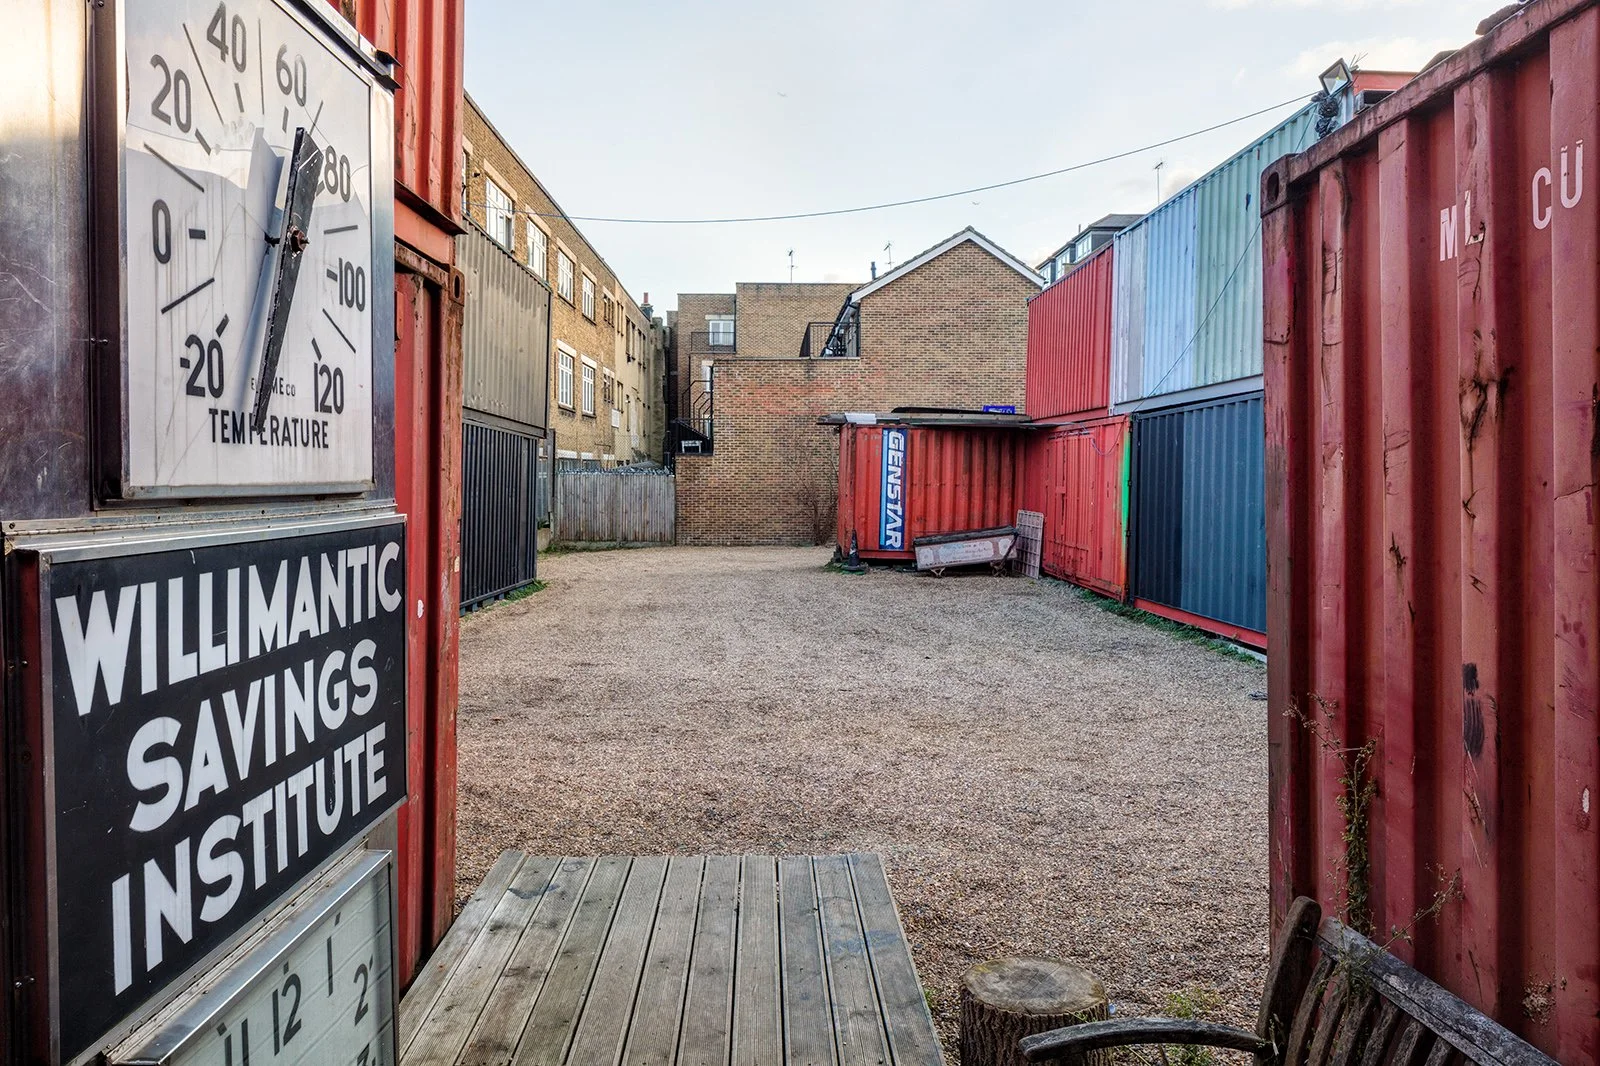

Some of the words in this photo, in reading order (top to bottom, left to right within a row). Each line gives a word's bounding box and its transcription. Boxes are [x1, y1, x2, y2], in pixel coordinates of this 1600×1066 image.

[206, 1, 247, 73] 40
[151, 54, 191, 134] 20
[276, 44, 307, 107] 60
[324, 145, 351, 202] 80
[152, 199, 172, 264] 0
[313, 362, 344, 414] 120
[886, 431, 905, 548] GENSTAR
[55, 542, 402, 716] WILLIMANTIC
[127, 639, 378, 832] SAVINGS
[112, 723, 387, 996] INSTITUTE
[272, 973, 302, 1056] 12
[353, 963, 369, 1026] 2
